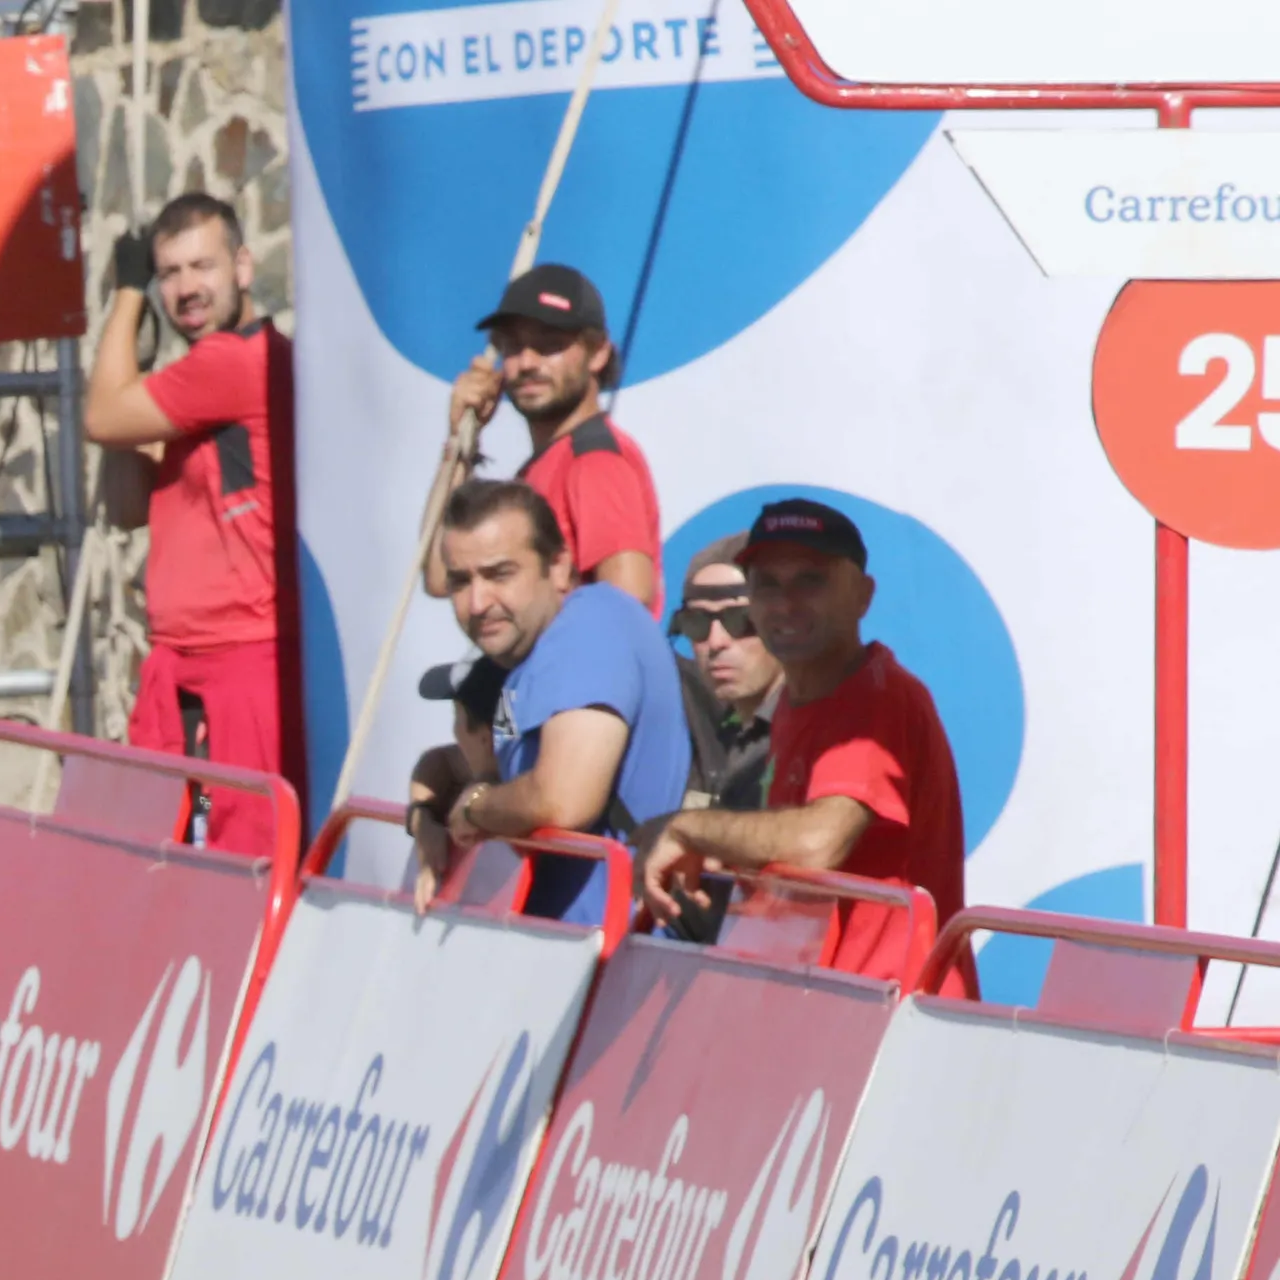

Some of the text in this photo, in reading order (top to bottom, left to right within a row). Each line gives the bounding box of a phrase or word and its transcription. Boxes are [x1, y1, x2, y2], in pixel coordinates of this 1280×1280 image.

[376, 17, 721, 83] CON EL DEPORTE
[212, 1041, 430, 1248] Carrefour
